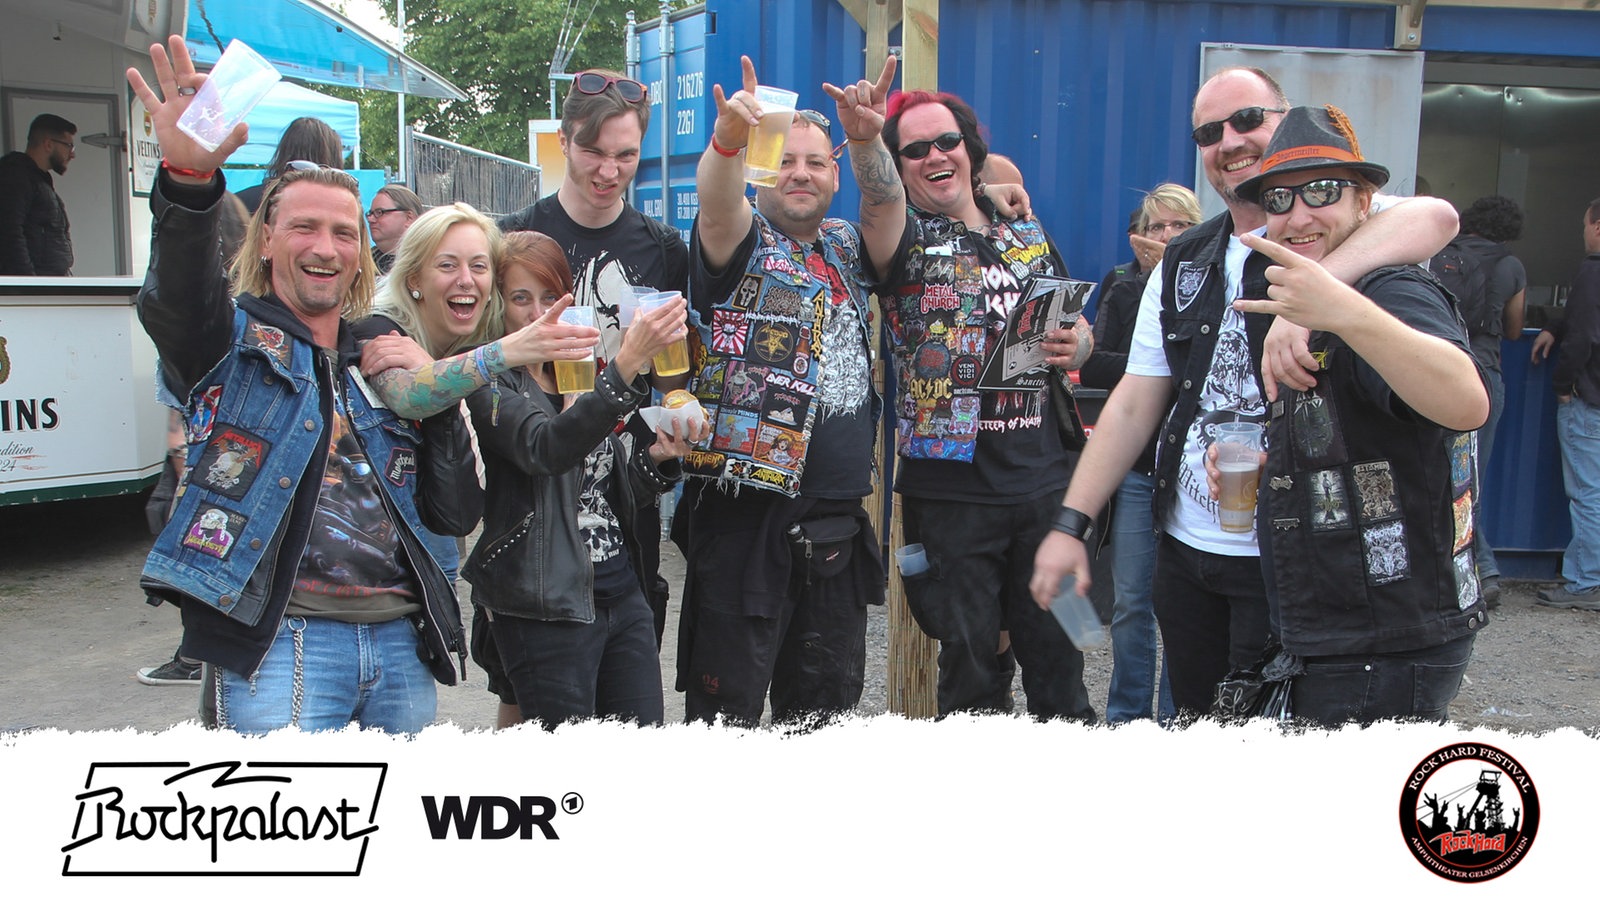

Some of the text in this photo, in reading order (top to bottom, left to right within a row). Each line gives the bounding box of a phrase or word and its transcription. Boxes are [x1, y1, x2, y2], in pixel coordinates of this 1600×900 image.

[677, 72, 704, 100] 216276
[677, 109, 695, 135] 22G1
[136, 139, 161, 160] VELTINS
[925, 282, 958, 297] METAL
[920, 294, 961, 314] CHURCH
[765, 371, 791, 388] OVER
[789, 379, 817, 398] KILL
[0, 397, 61, 432] INS
[1019, 415, 1042, 429] DEATH
